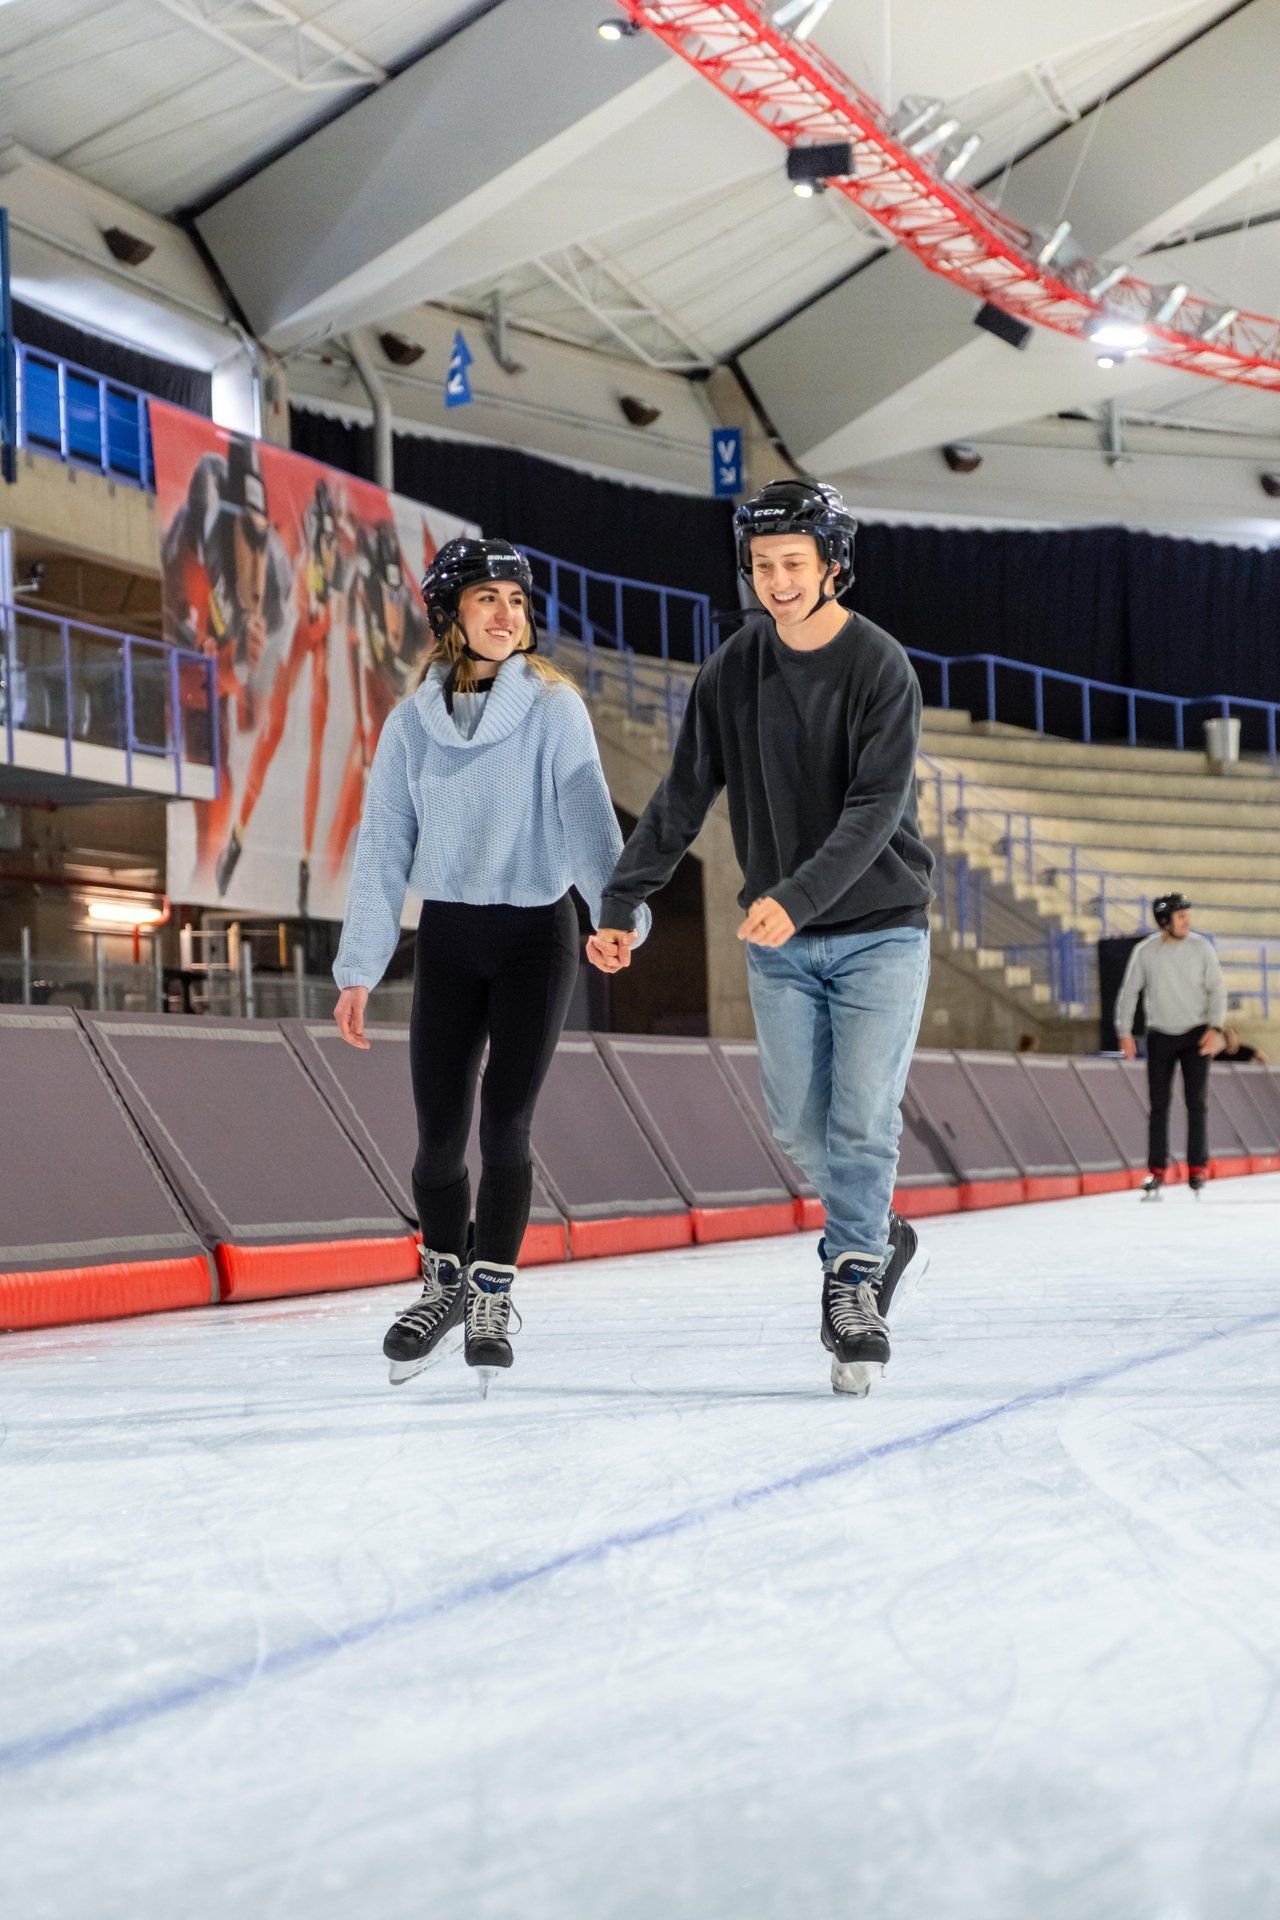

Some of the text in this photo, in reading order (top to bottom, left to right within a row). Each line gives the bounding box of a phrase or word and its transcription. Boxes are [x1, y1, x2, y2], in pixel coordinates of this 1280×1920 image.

[717, 439, 736, 464] V
[753, 508, 786, 517] CCM
[478, 1273, 512, 1284] BAUER
